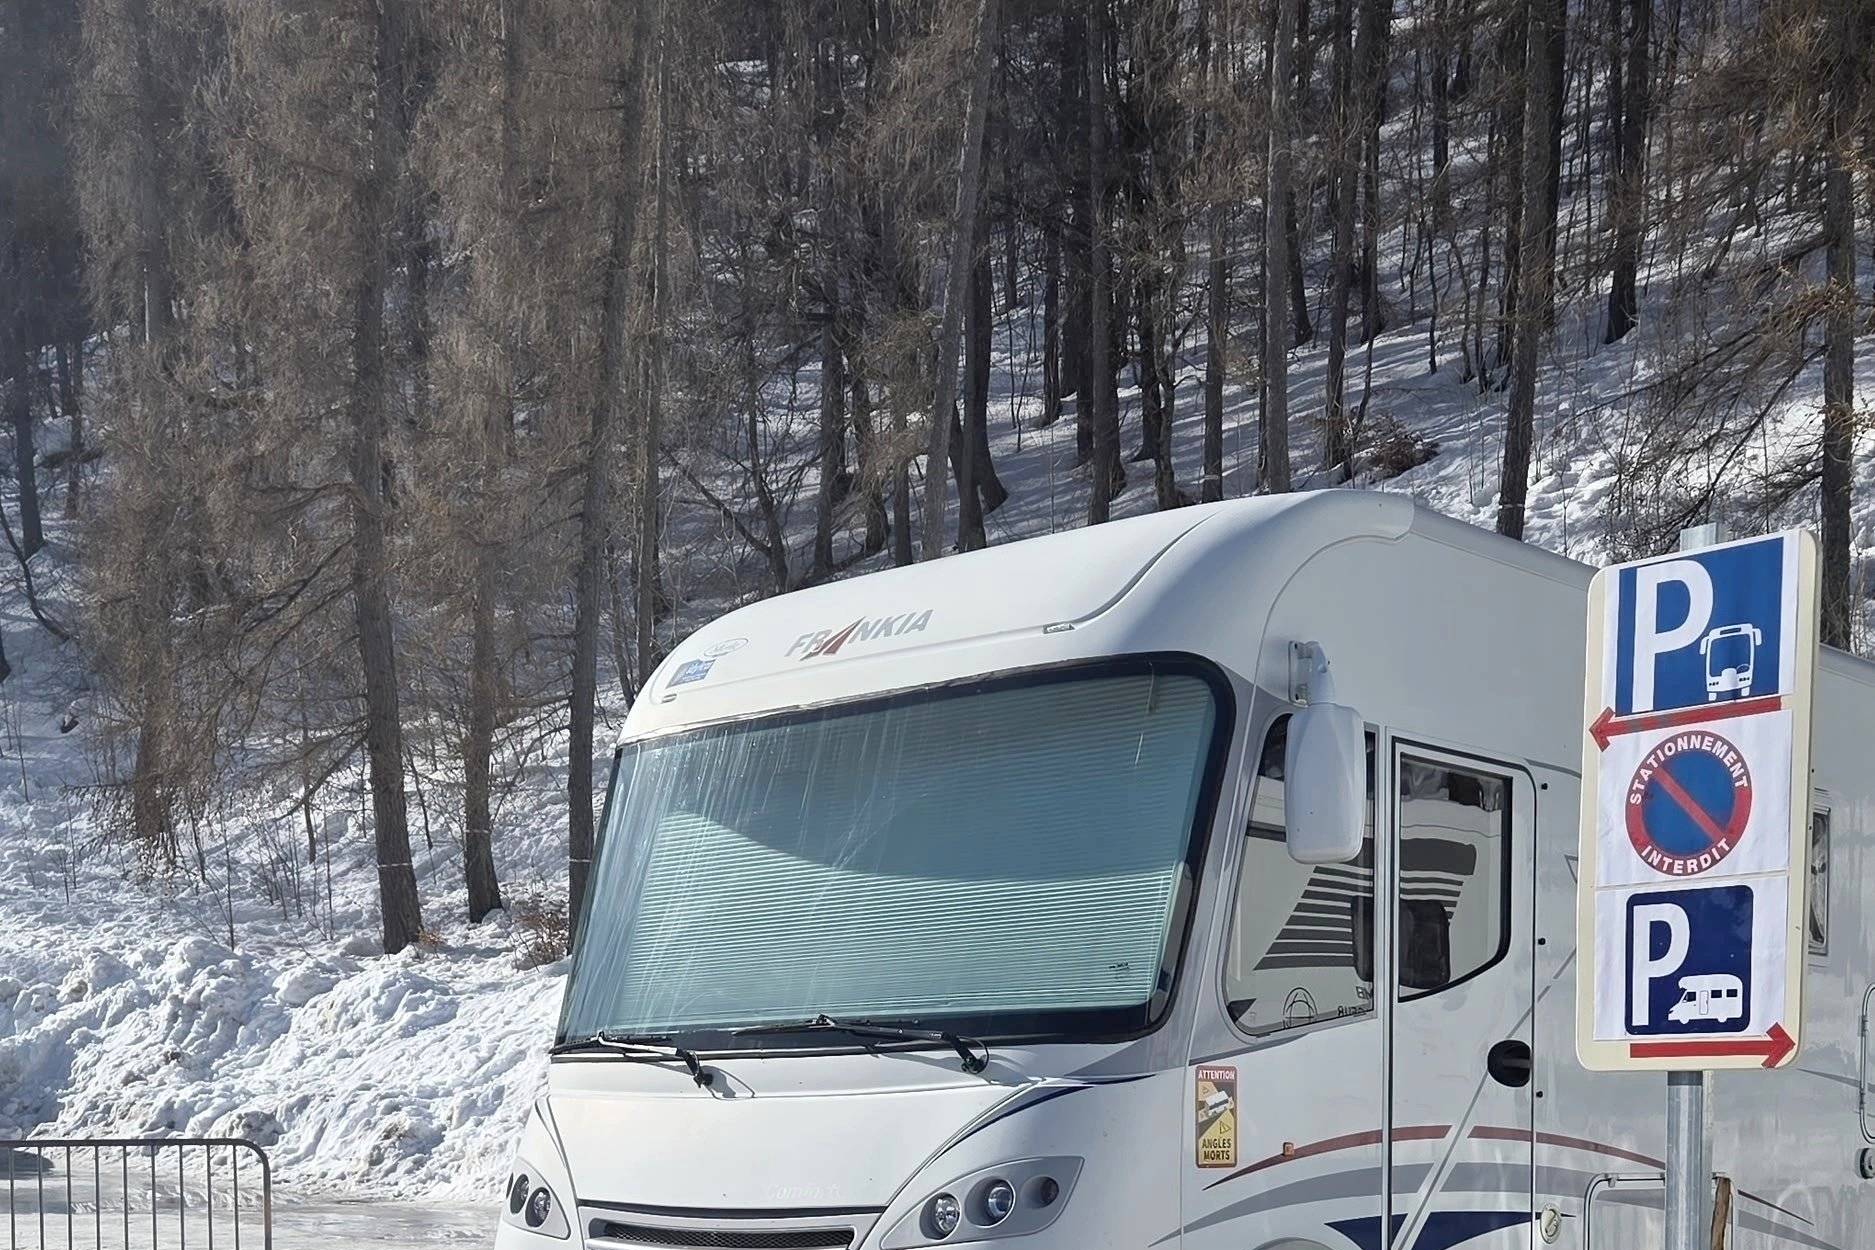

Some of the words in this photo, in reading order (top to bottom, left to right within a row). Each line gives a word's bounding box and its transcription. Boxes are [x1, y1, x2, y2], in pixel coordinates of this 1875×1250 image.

[1631, 559, 1714, 713] P
[1630, 734, 1748, 805] STATIONNEMENT
[1641, 837, 1730, 874] INTERDIT
[1631, 902, 1691, 1026] P
[1198, 1069, 1235, 1080] ATTENTION
[1202, 1138, 1231, 1149] ANGLES
[1203, 1150, 1230, 1161] MORTS
